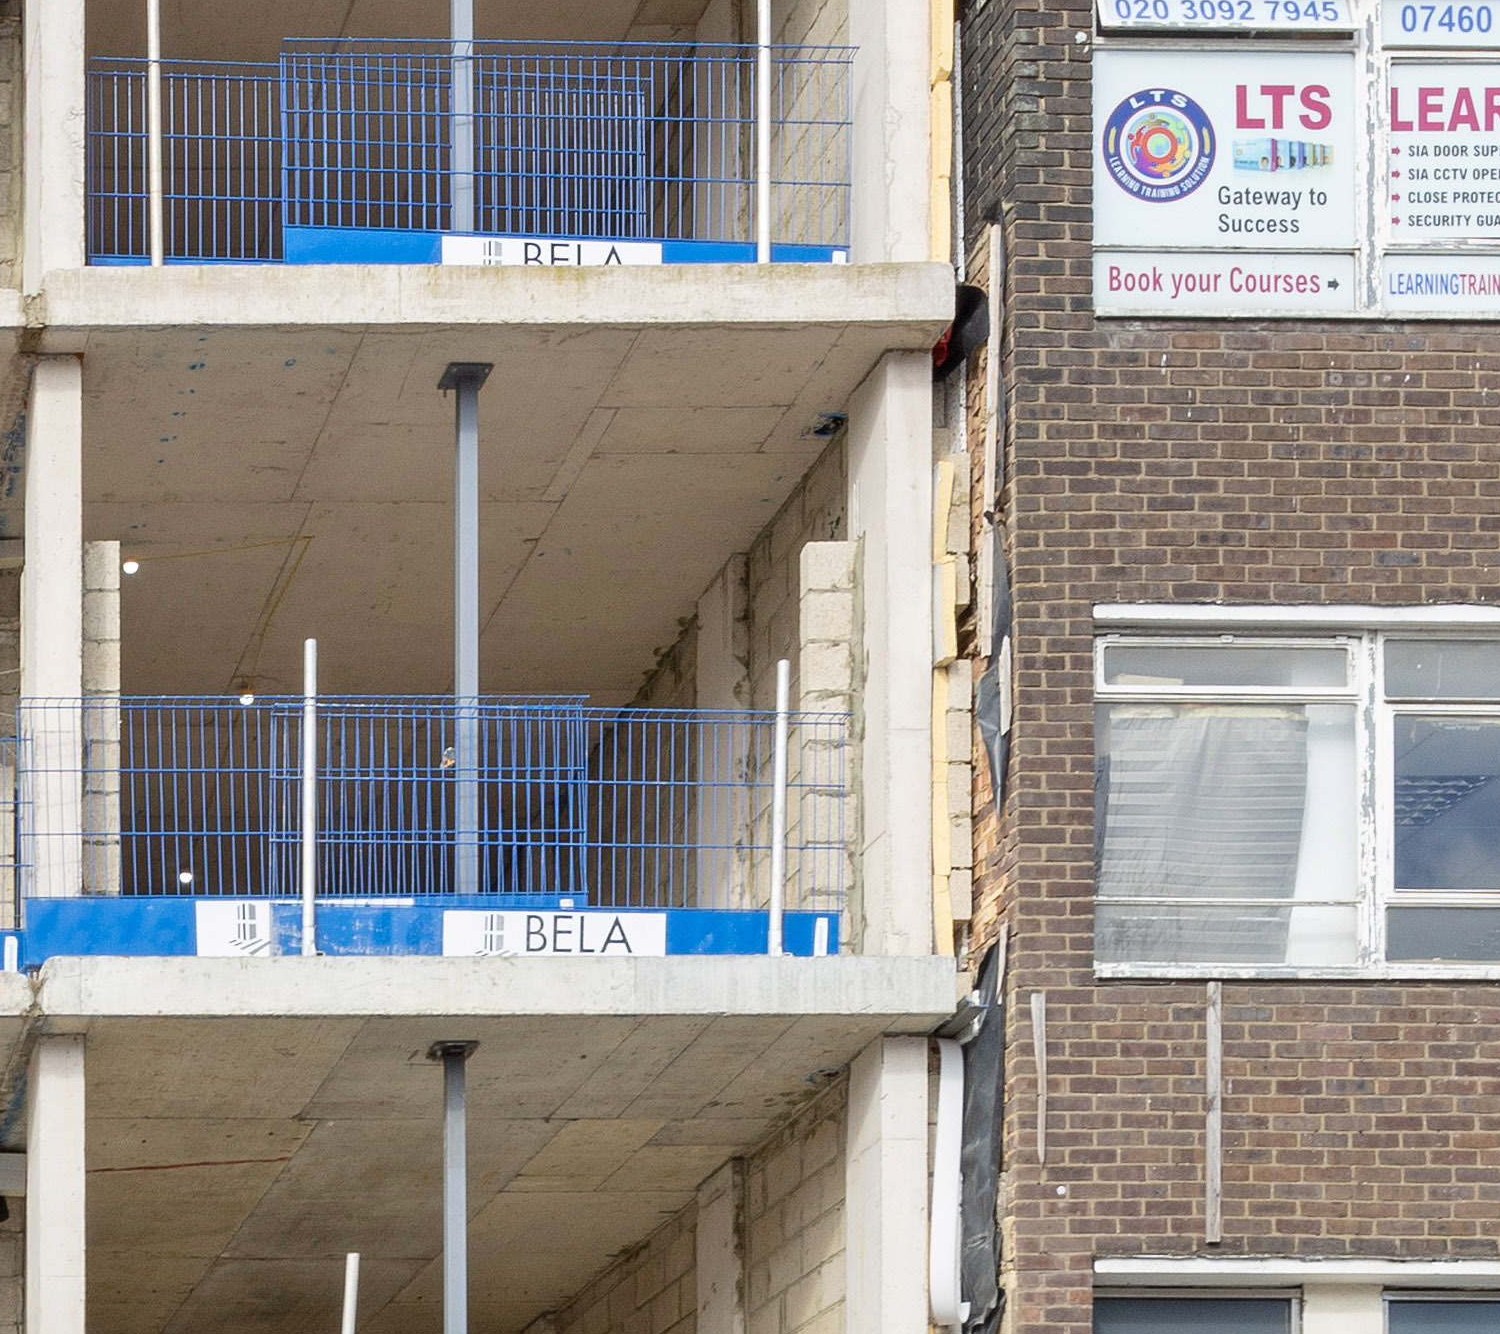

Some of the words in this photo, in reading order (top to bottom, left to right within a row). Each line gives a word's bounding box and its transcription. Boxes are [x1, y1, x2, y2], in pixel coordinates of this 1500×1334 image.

[1266, 0, 1340, 21] 7945
[1402, 5, 1491, 32] 07460
[1129, 90, 1188, 109] LTS
[1236, 85, 1331, 130] LTS
[1409, 146, 1428, 156] SIA
[1434, 145, 1468, 156] DOOR
[1409, 169, 1428, 180] SIA
[1434, 169, 1467, 180] CCTV
[1219, 186, 1301, 210] Gateway
[1310, 189, 1326, 205] to
[1409, 192, 1447, 203] CLOSE
[1219, 214, 1299, 233] Success
[1409, 215, 1471, 226] SECURITY
[1110, 266, 1162, 291] Book
[1171, 274, 1221, 299] your
[1230, 267, 1320, 293] Courses
[527, 915, 632, 953] BELA
